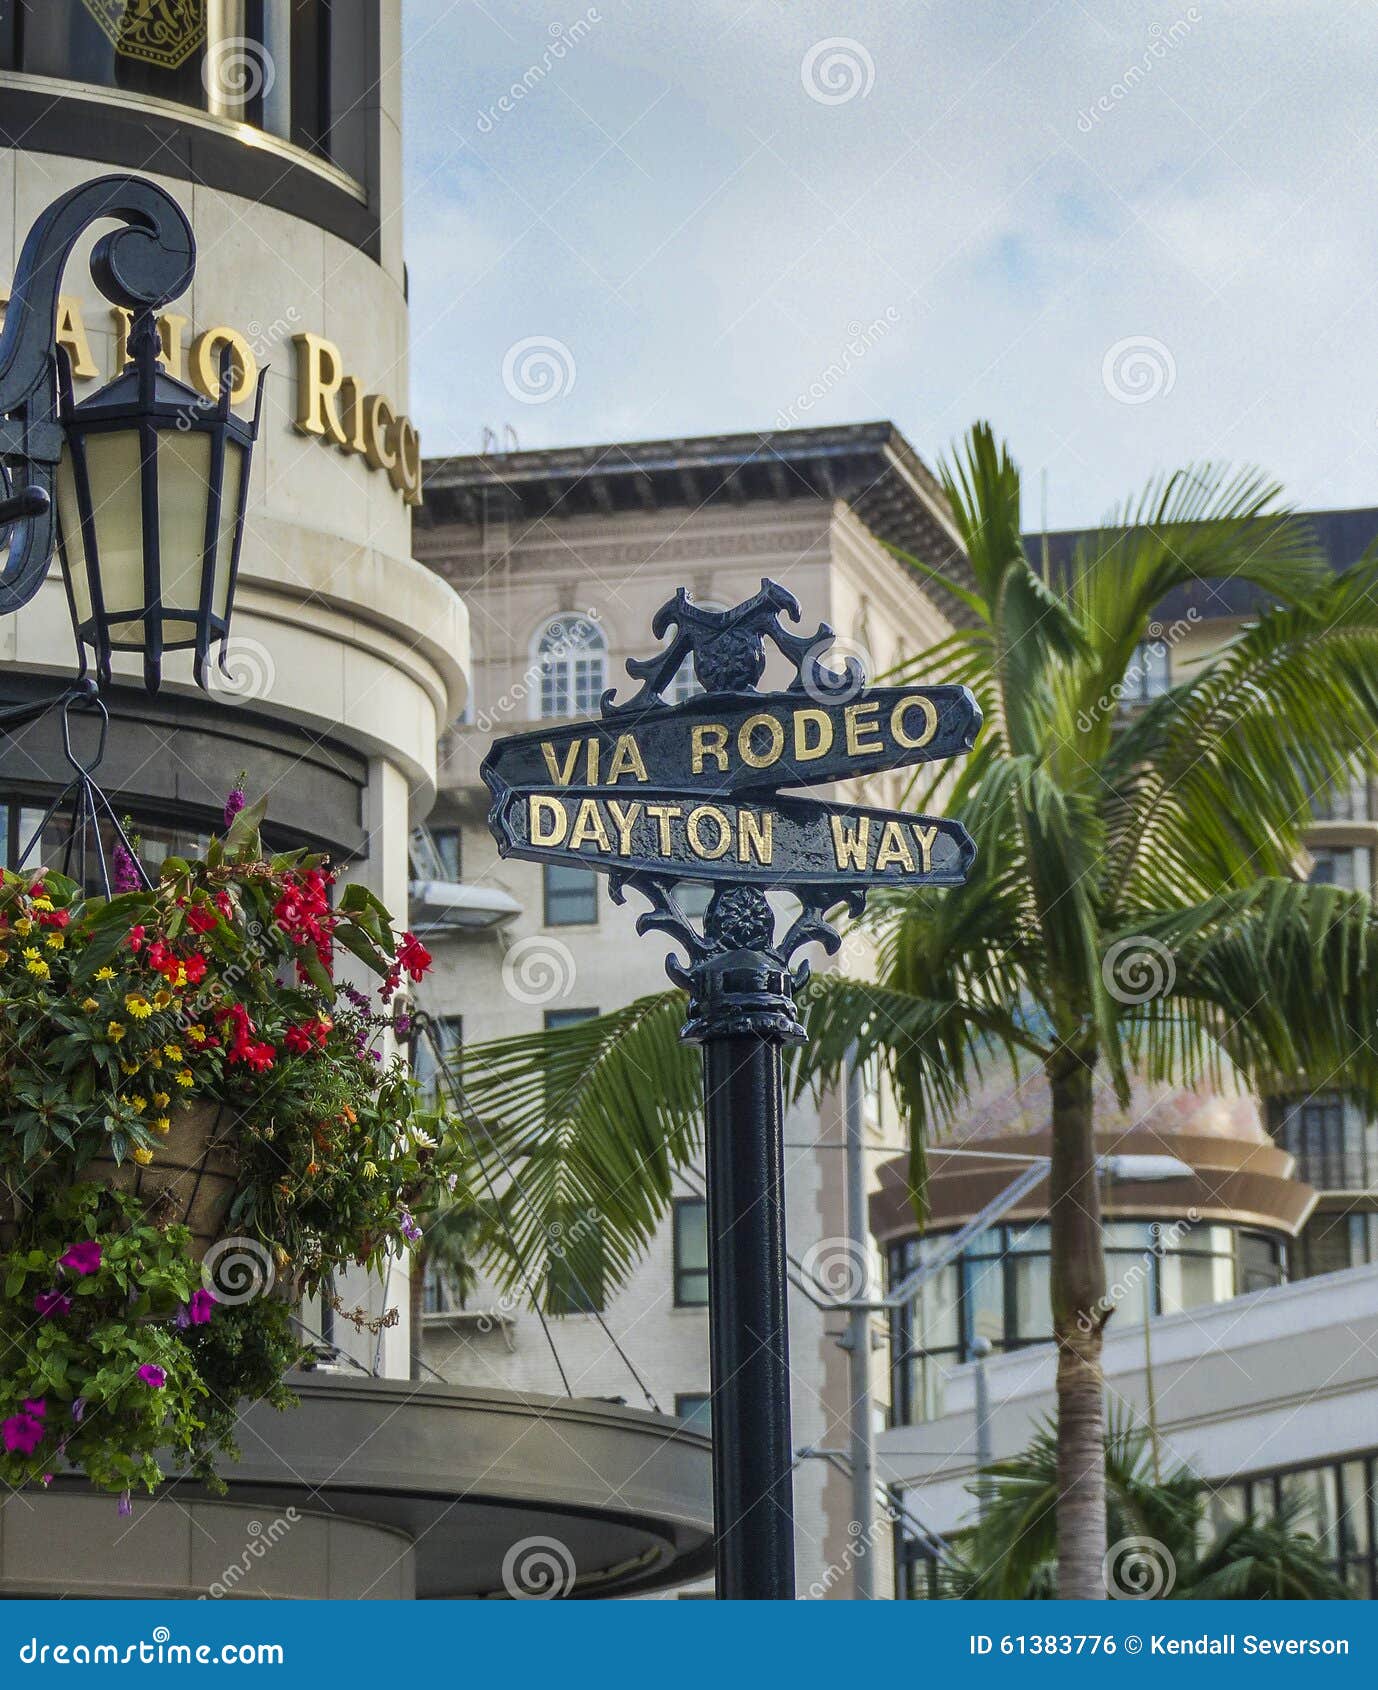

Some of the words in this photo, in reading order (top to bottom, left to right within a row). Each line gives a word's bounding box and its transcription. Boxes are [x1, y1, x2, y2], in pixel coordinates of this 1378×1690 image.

[0, 291, 256, 405] ANO
[540, 733, 649, 787] VIA
[691, 695, 938, 774] RODEO
[529, 795, 773, 865] DAYTON
[830, 815, 938, 874] WAY
